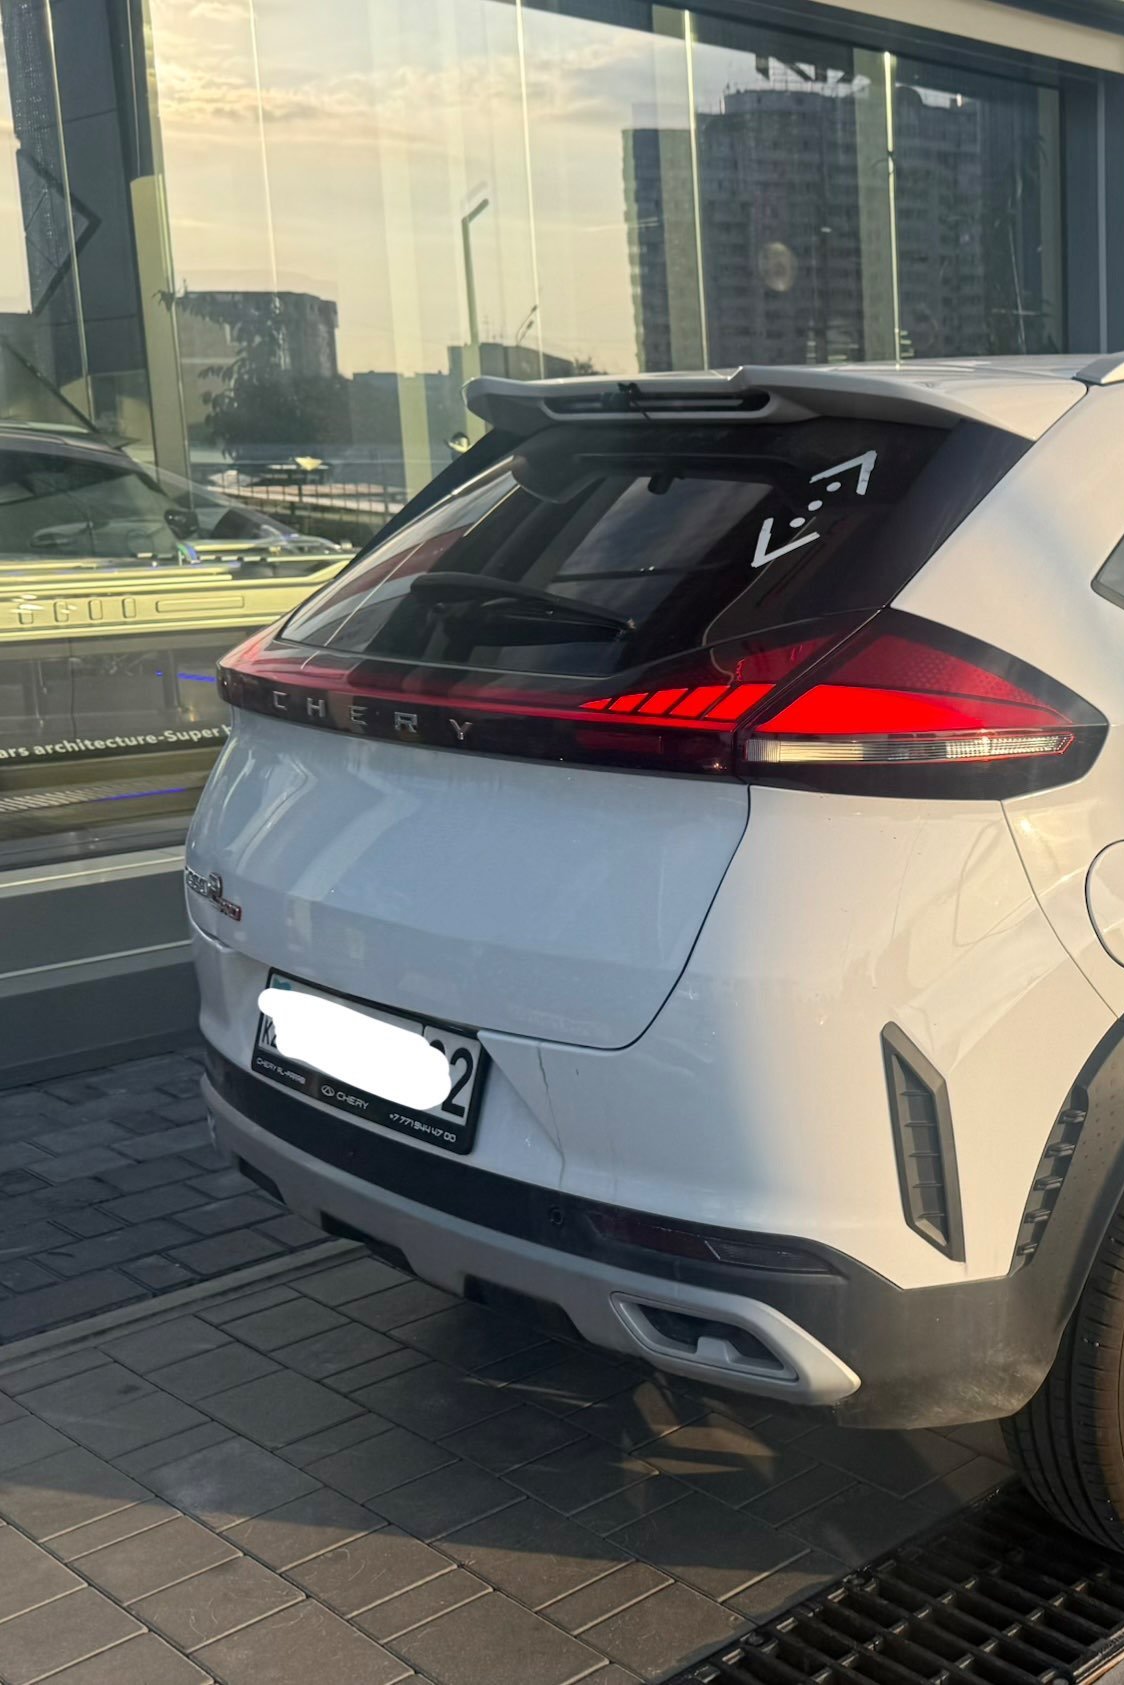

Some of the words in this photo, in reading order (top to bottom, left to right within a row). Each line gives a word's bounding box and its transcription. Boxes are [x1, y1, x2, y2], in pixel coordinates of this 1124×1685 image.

[272, 690, 473, 741] CHERY
[33, 728, 219, 755] architecture-Super
[336, 1091, 369, 1110] CHERY
